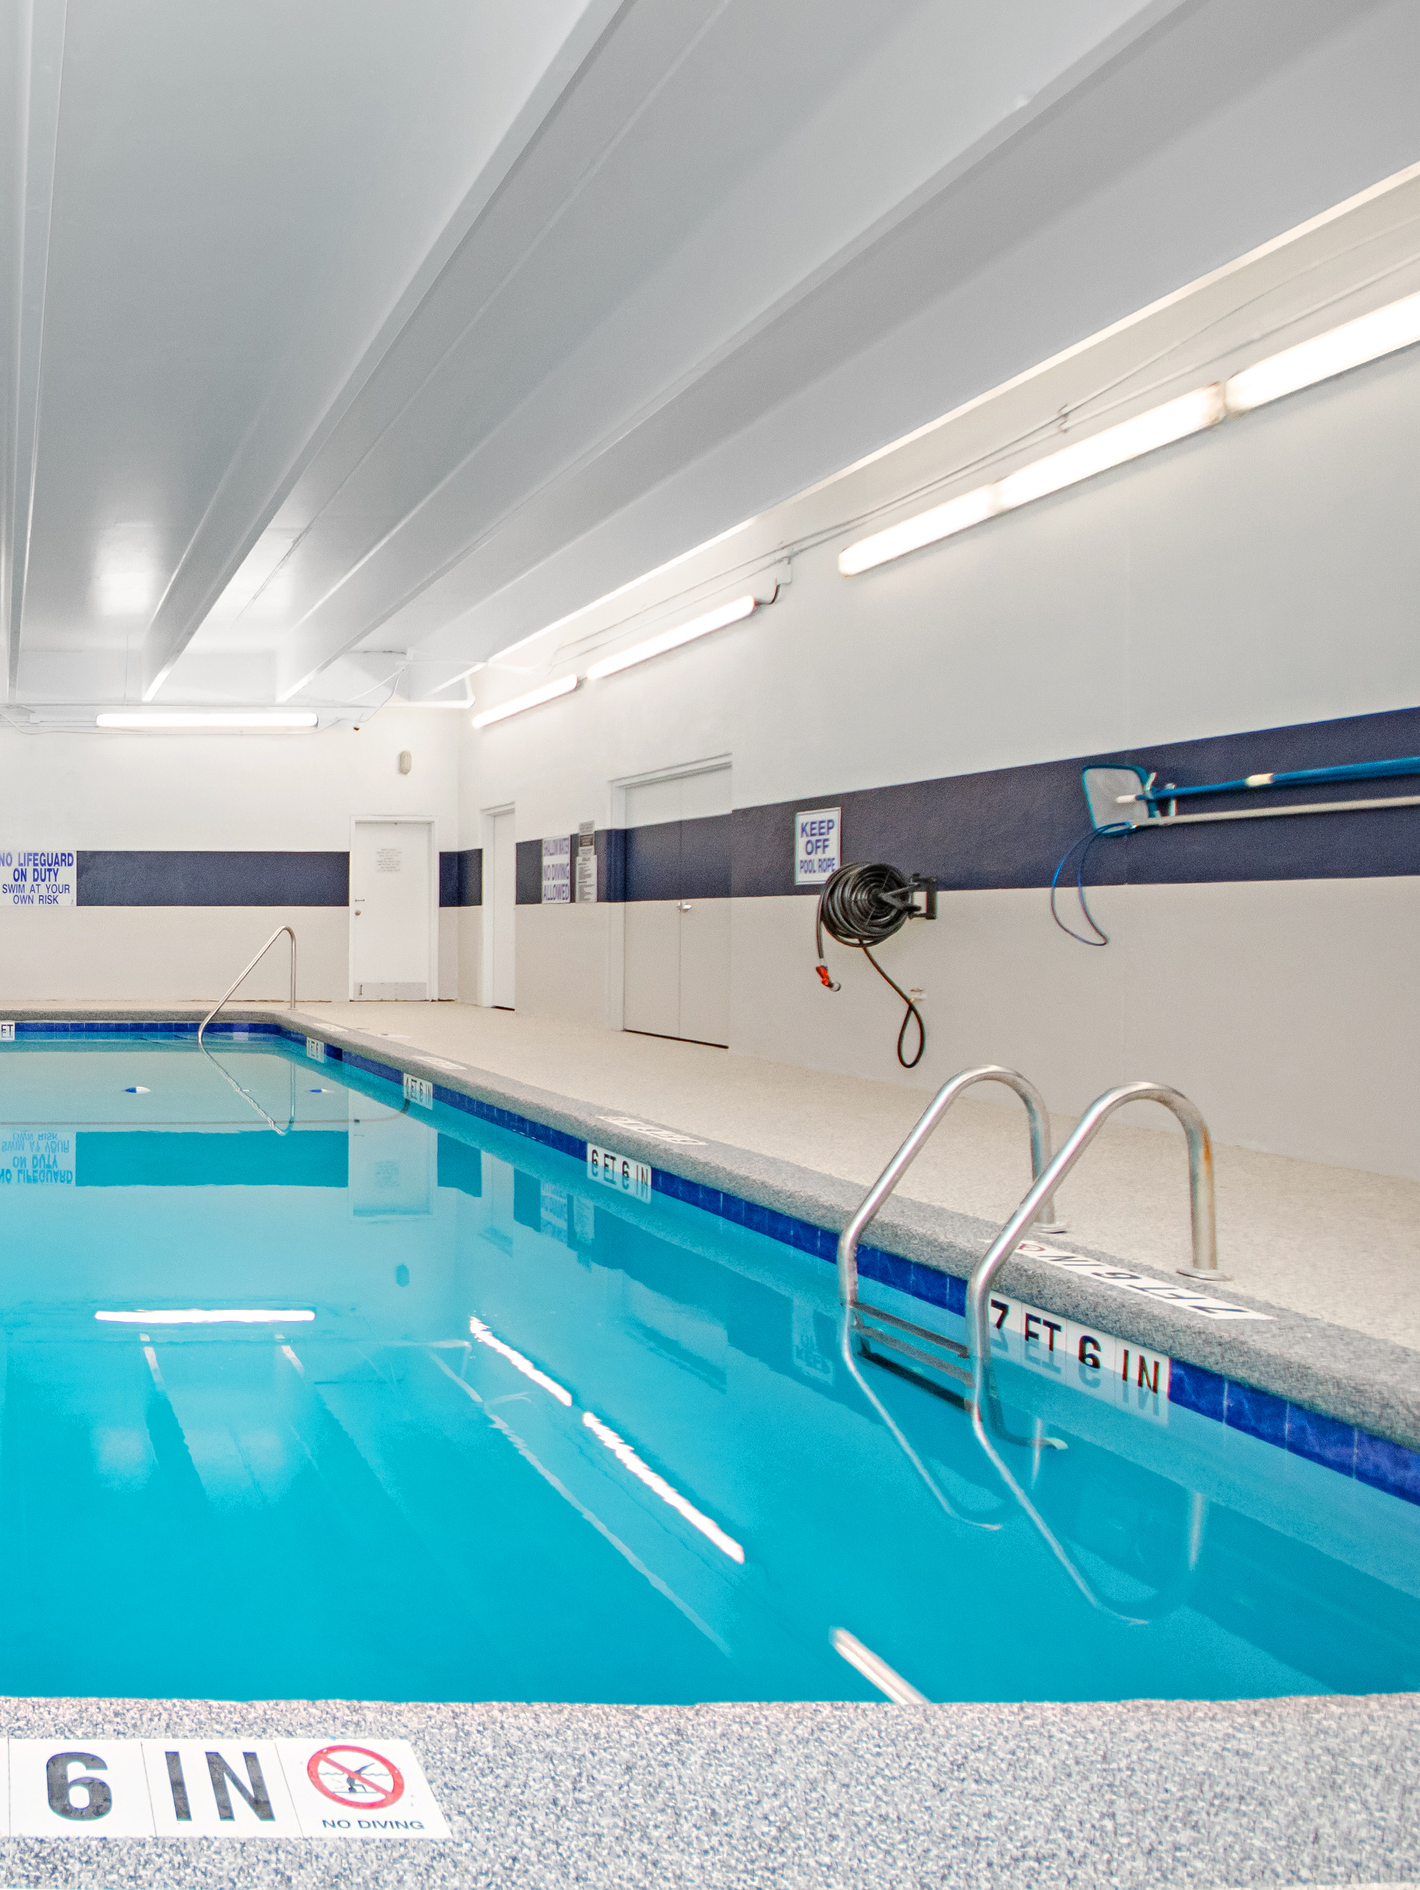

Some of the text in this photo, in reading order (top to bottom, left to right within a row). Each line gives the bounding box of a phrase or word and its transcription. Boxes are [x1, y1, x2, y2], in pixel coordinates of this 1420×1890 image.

[800, 819, 835, 838] KEEP
[805, 838, 830, 855] OFF
[17, 852, 74, 867] LIFEGUARD
[799, 857, 836, 874] POOL ROPE
[13, 868, 59, 882] ON DUTY
[2, 884, 70, 894] SWIM AT YOUR
[13, 894, 59, 904] OWN RISK
[1037, 1255, 1250, 1314] 7 FT 6 IN
[990, 1298, 1160, 1394] 7 FT 6 IN
[46, 1751, 113, 1821] 6
[165, 1750, 276, 1821] IN
[322, 1819, 425, 1830] NO DIVING
